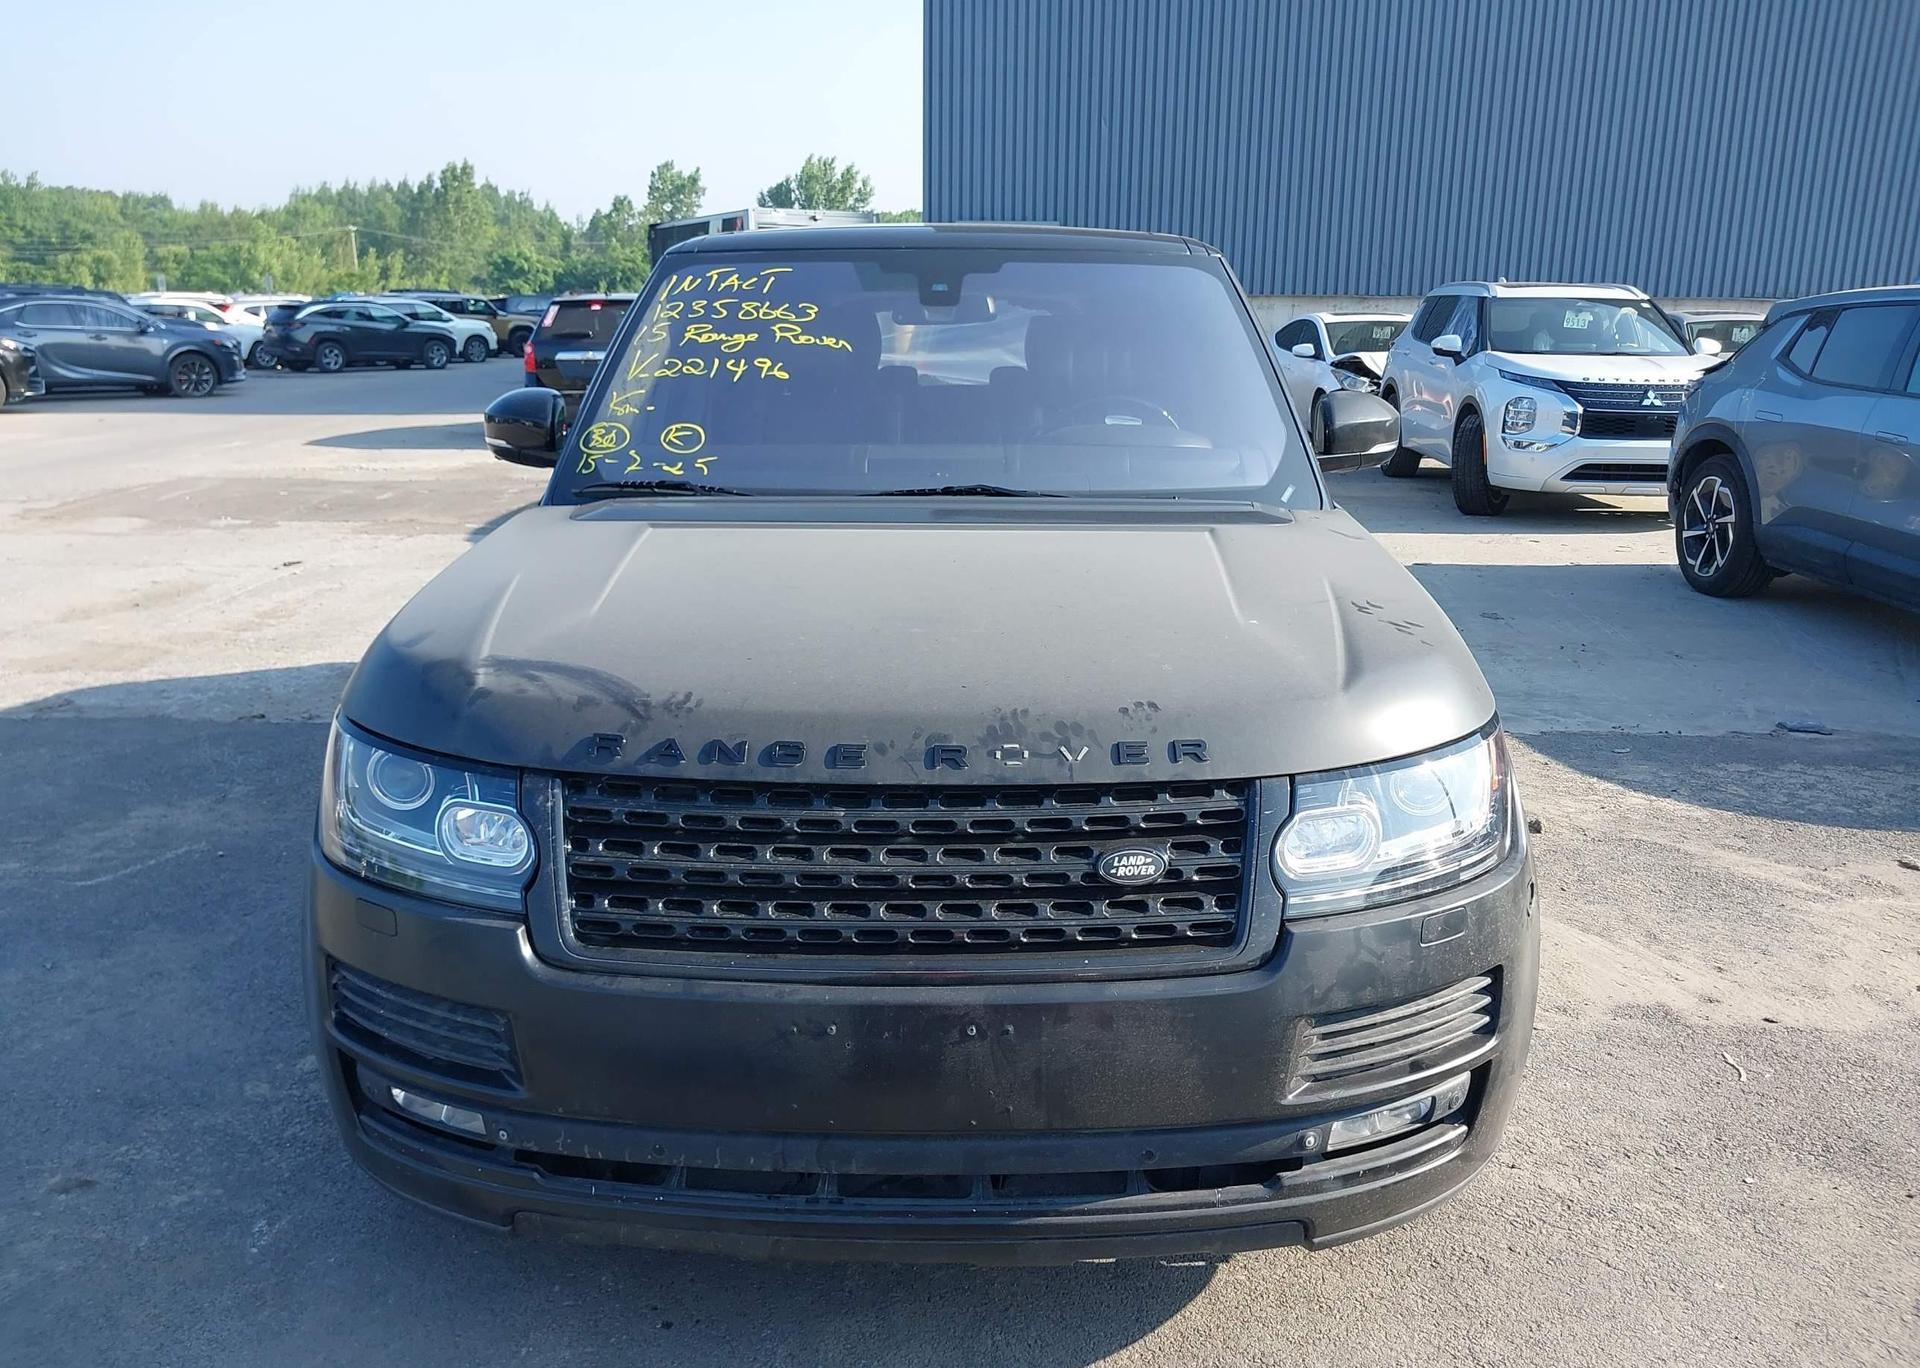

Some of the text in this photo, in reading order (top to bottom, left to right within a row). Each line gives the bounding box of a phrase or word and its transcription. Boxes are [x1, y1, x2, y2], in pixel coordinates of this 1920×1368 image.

[660, 267, 794, 300] INTACT
[653, 299, 819, 322] 12358663
[633, 322, 853, 353] 15 Range Rover
[592, 732, 1211, 769] RANGE ROVER
[1113, 855, 1145, 867] LAND
[1116, 865, 1156, 877] ROVER
